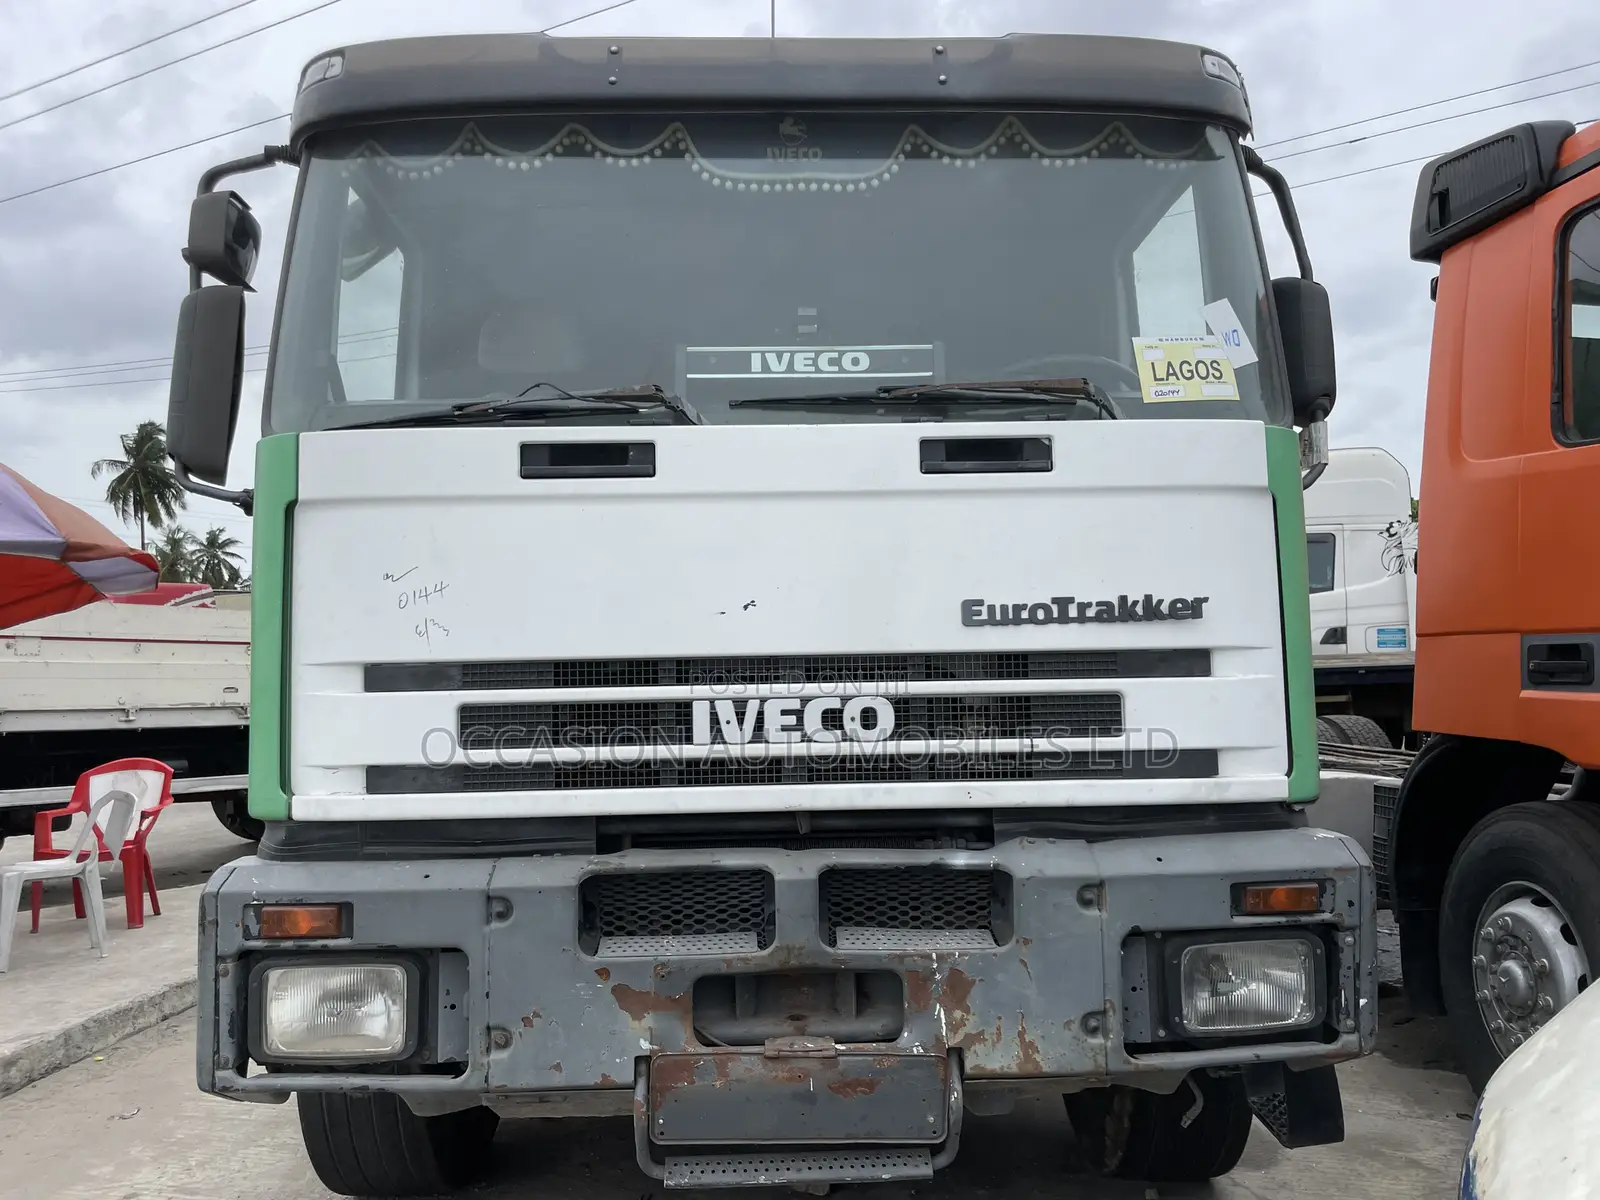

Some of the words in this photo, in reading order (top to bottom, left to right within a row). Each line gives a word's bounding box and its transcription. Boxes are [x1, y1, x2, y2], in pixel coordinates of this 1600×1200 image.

[766, 146, 823, 163] IVECO
[751, 351, 870, 373] IVECO
[1150, 359, 1224, 382] LAGOS
[961, 594, 1210, 627] EuroTrakker
[692, 696, 896, 745] IVECO
